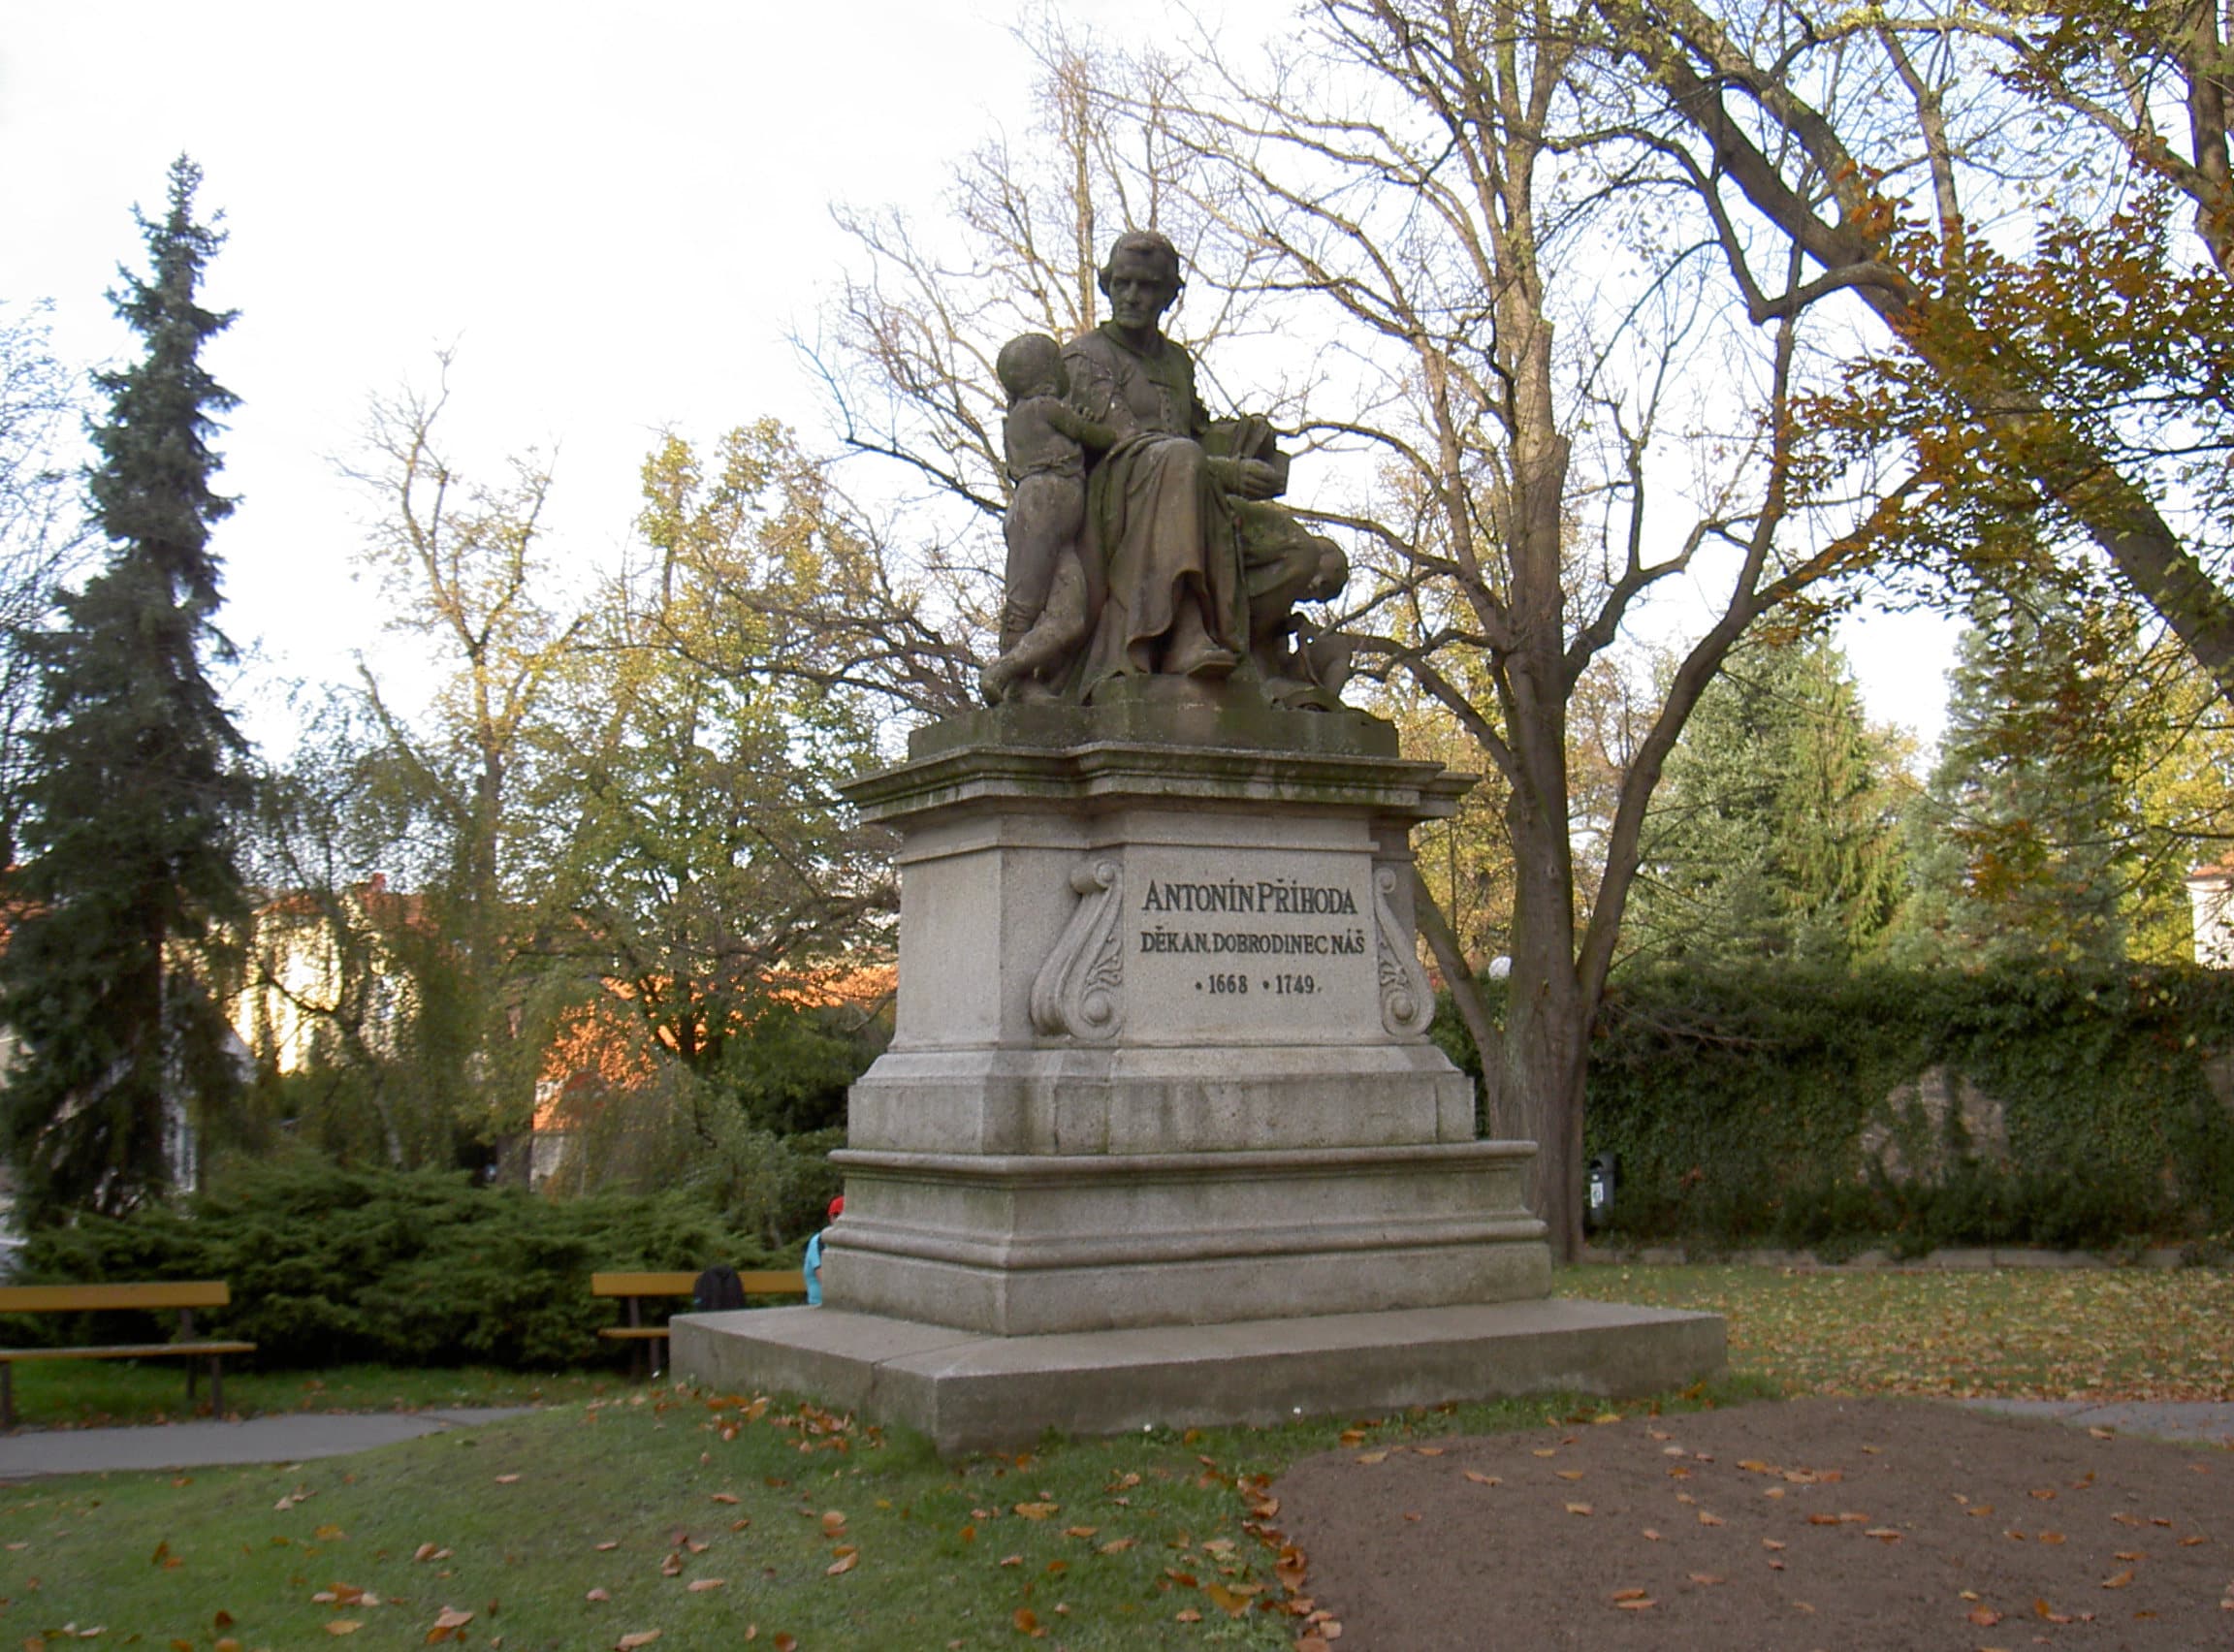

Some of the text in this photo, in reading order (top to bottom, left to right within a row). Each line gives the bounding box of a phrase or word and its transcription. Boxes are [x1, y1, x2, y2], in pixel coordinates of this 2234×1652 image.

[1141, 877, 1358, 915] ANTONÍN PŘÍHODA
[1213, 932, 1328, 955] DOBRODINEC
[1330, 928, 1365, 955] NÁŠ
[1209, 973, 1248, 994] 1668
